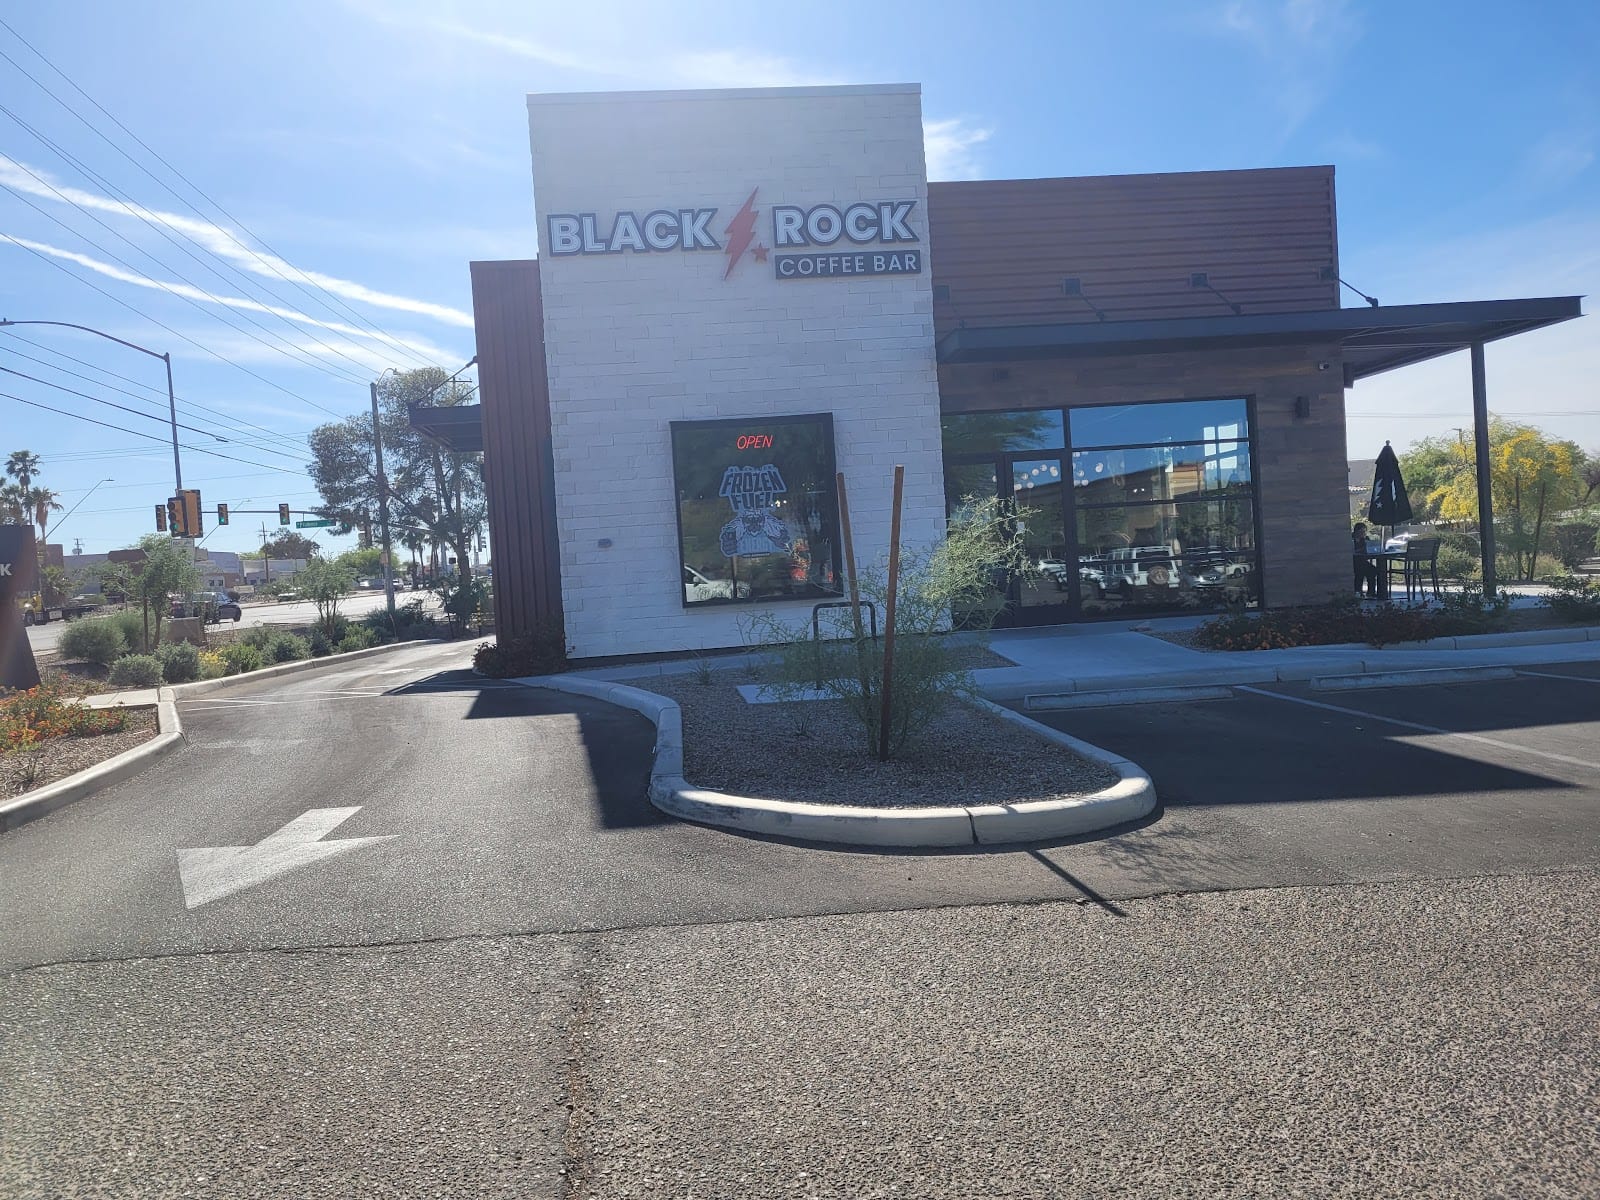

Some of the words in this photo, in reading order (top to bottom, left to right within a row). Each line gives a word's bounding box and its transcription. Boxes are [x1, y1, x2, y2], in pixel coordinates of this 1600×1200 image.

[547, 208, 720, 256] BLACK
[774, 202, 919, 247] ROCK
[779, 253, 865, 276] COFFEE
[873, 253, 917, 272] BAR
[736, 435, 773, 449] OPEN
[720, 470, 786, 496] FROZEN
[731, 493, 772, 510] FUEL
